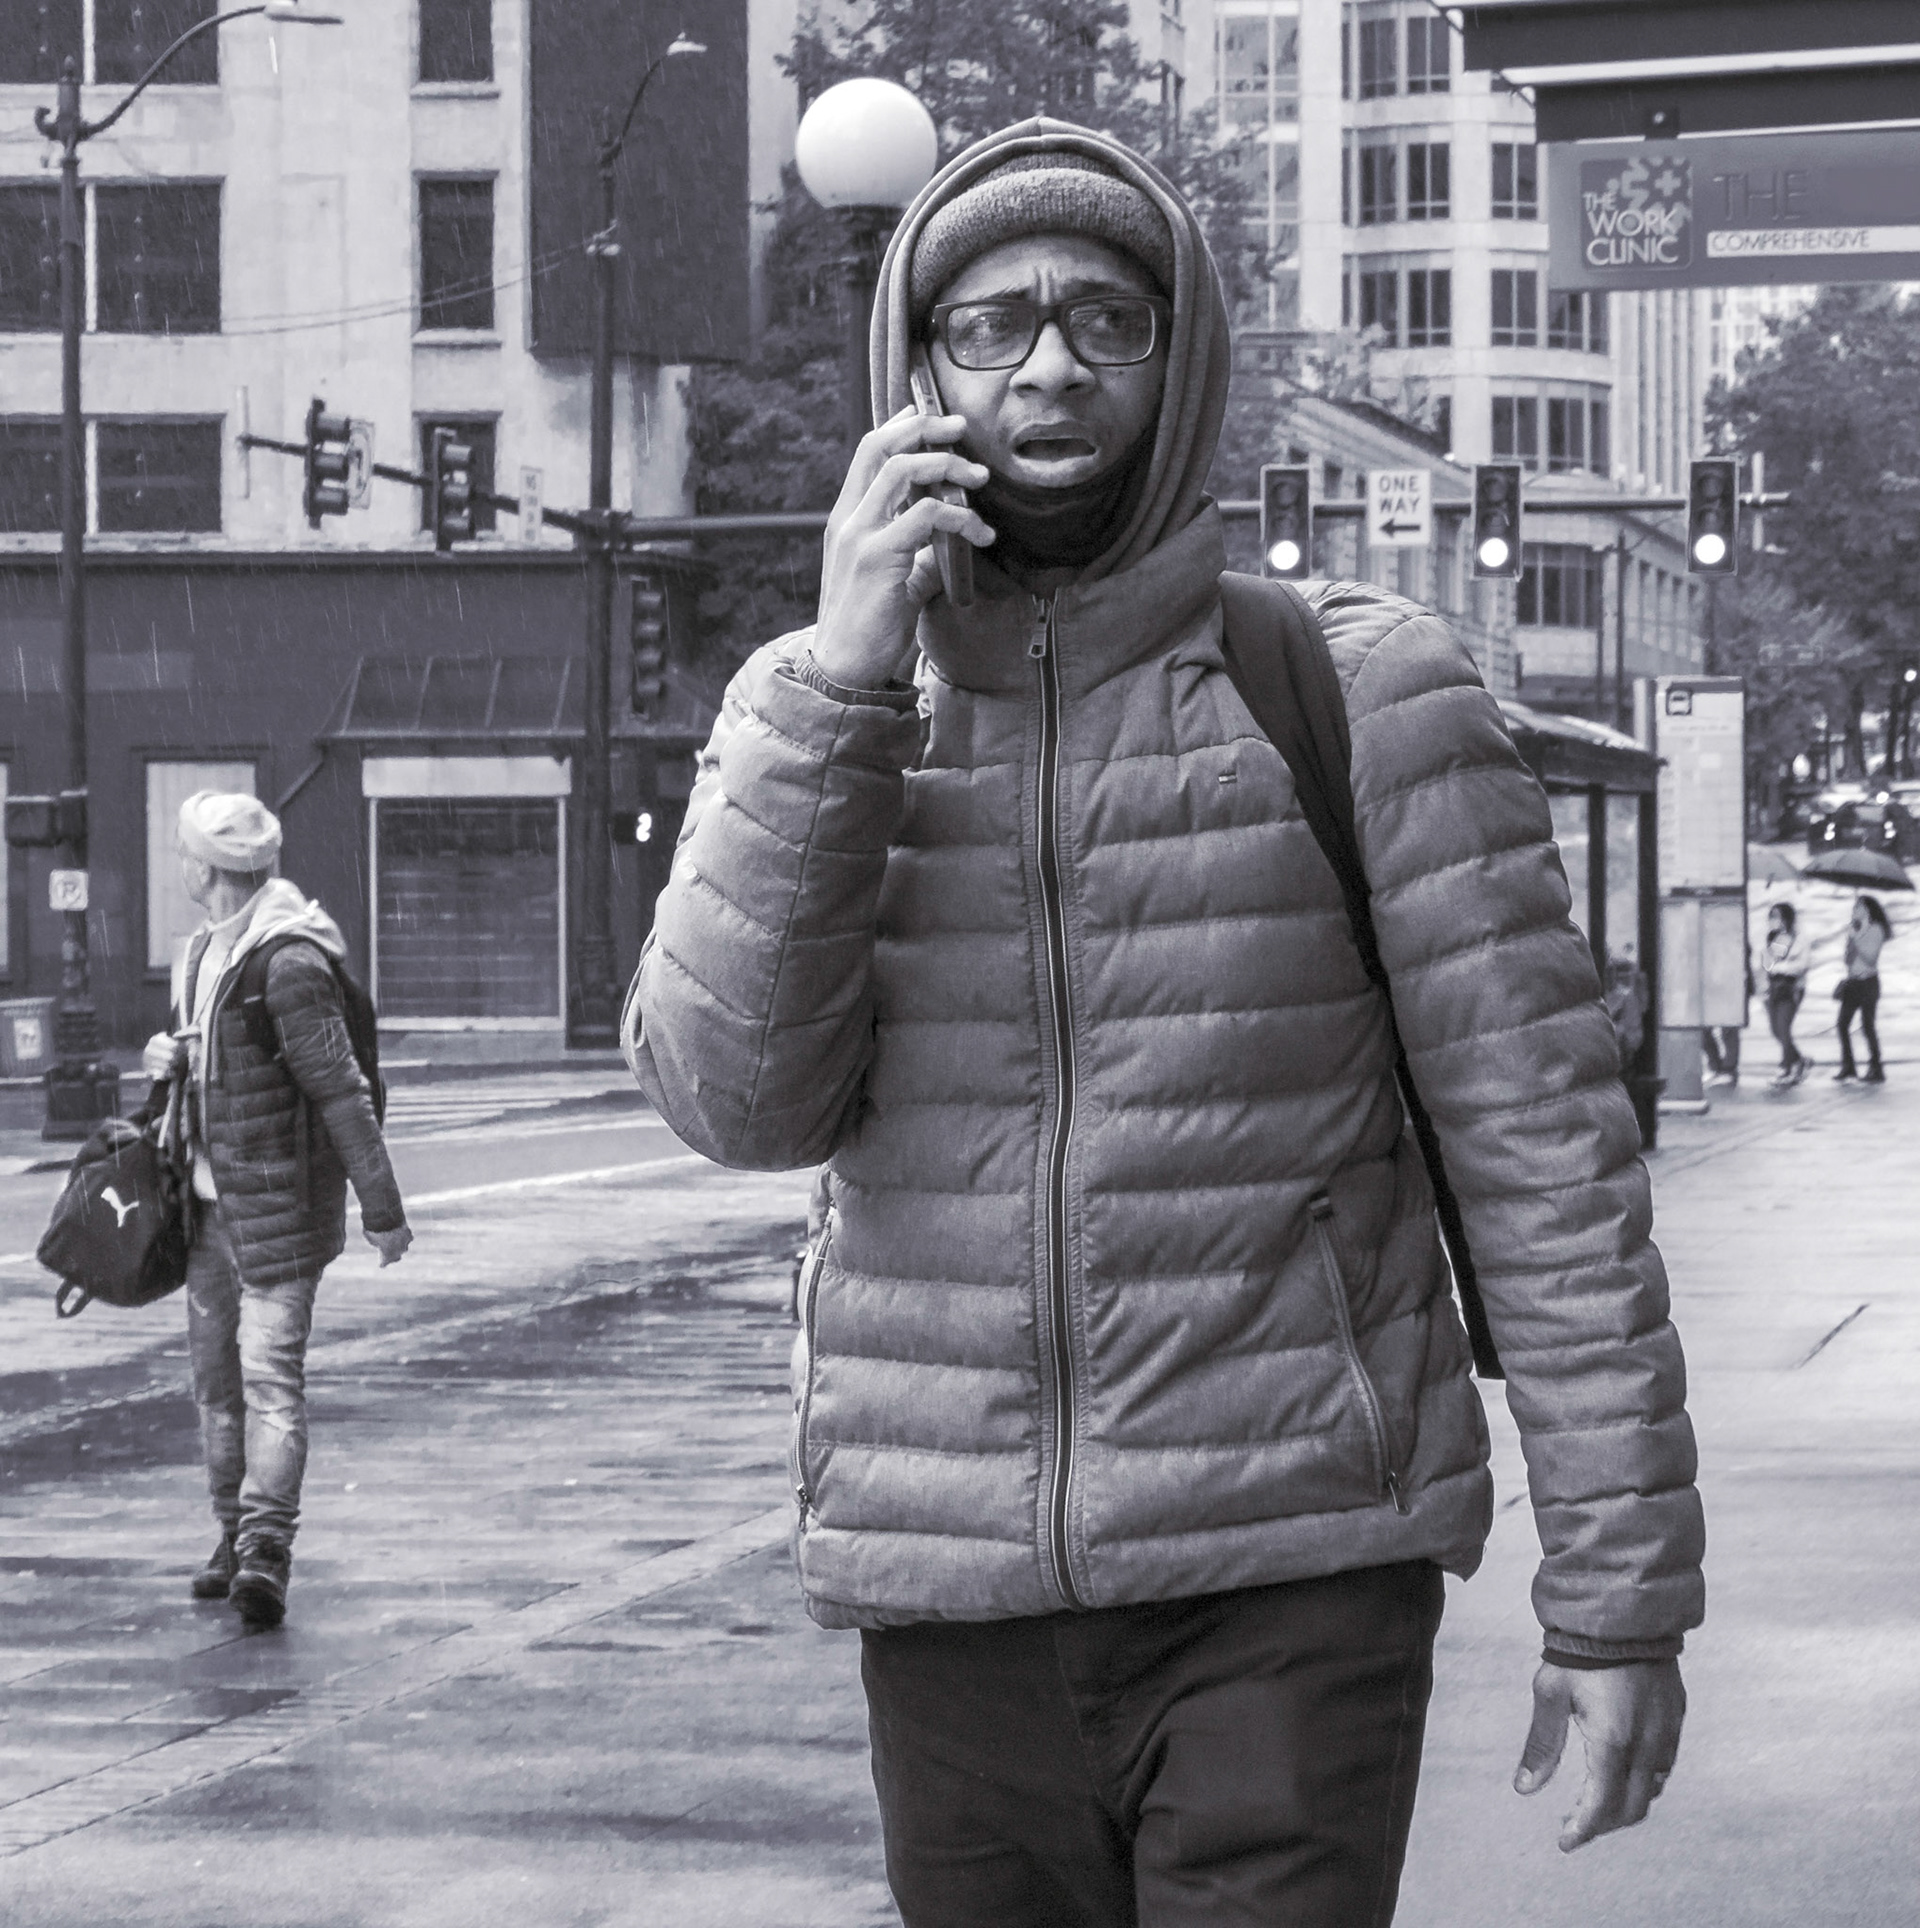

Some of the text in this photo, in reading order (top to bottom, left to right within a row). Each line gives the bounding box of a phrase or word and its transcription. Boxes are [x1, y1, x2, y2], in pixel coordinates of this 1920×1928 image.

[1583, 191, 1617, 211] THE
[1712, 172, 1808, 222] THE
[1587, 209, 1678, 237] WORK
[1586, 236, 1679, 266] CLINIC
[1712, 229, 1870, 252] COMPREHENSIVE
[1379, 475, 1419, 493] ONE
[1380, 497, 1420, 513] WAY
